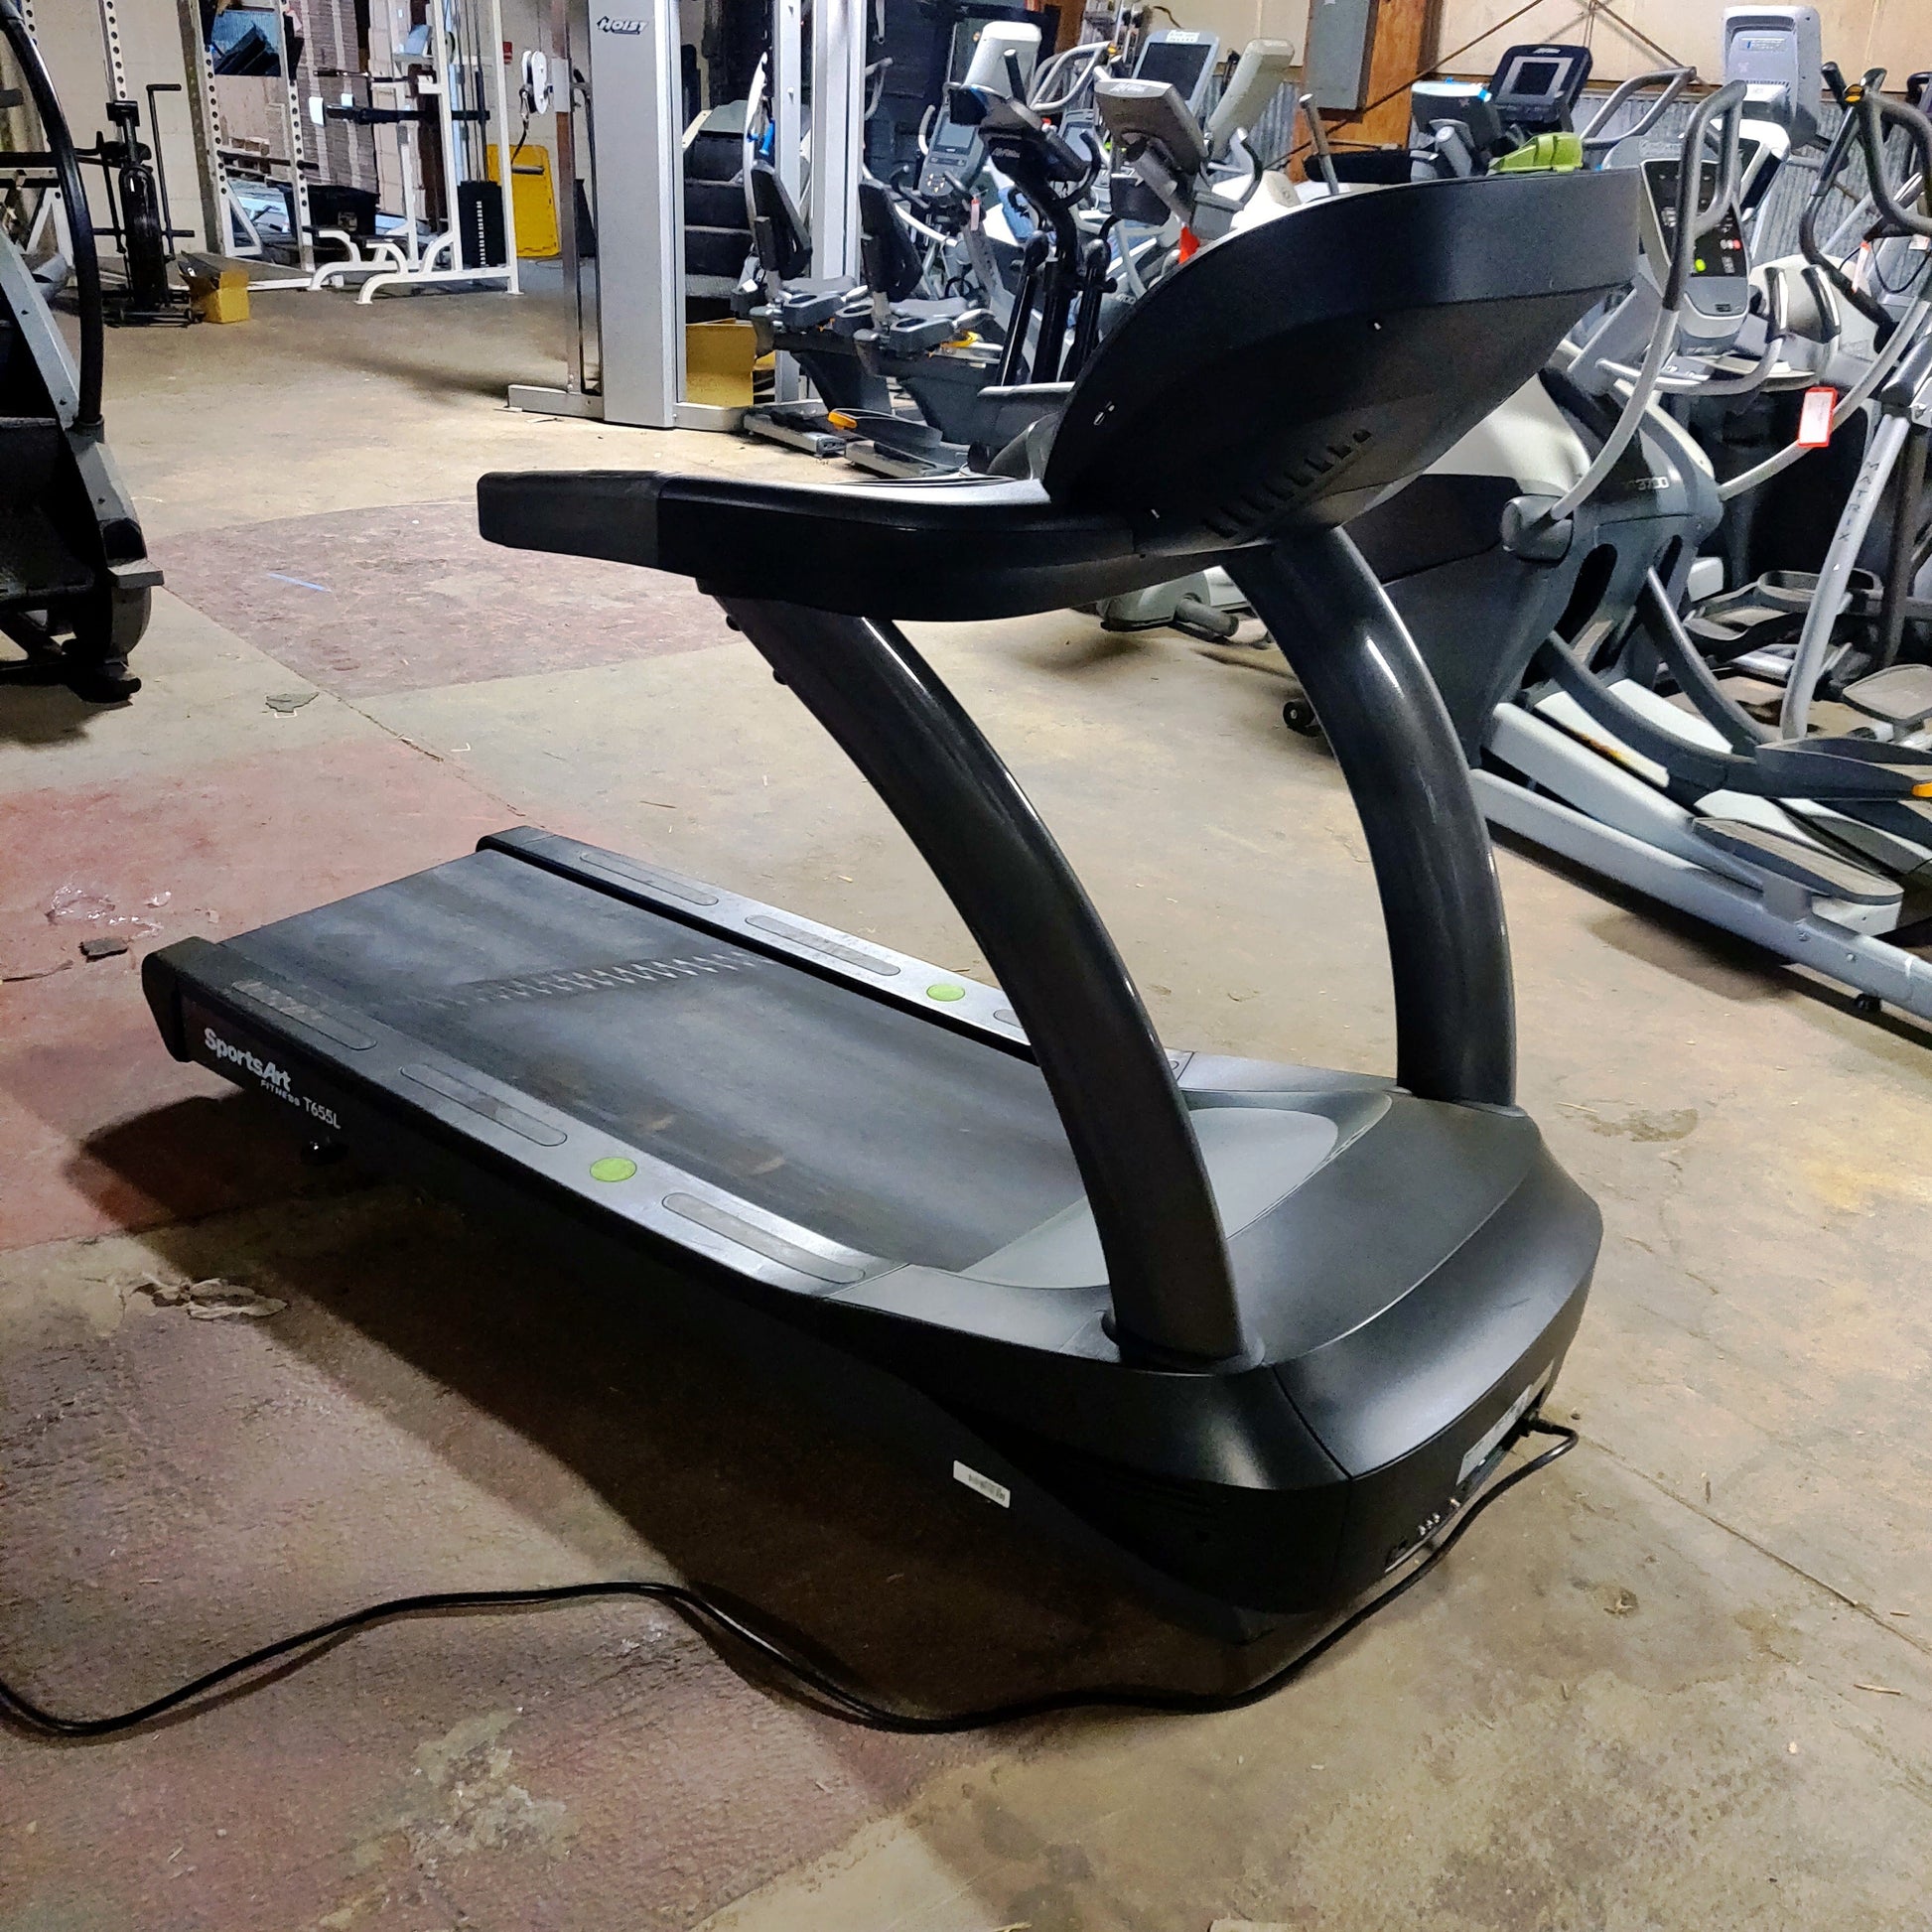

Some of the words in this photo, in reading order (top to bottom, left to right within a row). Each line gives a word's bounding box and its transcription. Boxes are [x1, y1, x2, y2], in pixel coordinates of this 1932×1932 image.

[597, 16, 648, 34] HOIST
[1838, 461, 1880, 542] MATRIX
[205, 1028, 291, 1092] SportsArt
[260, 1079, 301, 1106] FITNESS
[303, 1096, 342, 1129] T655L
